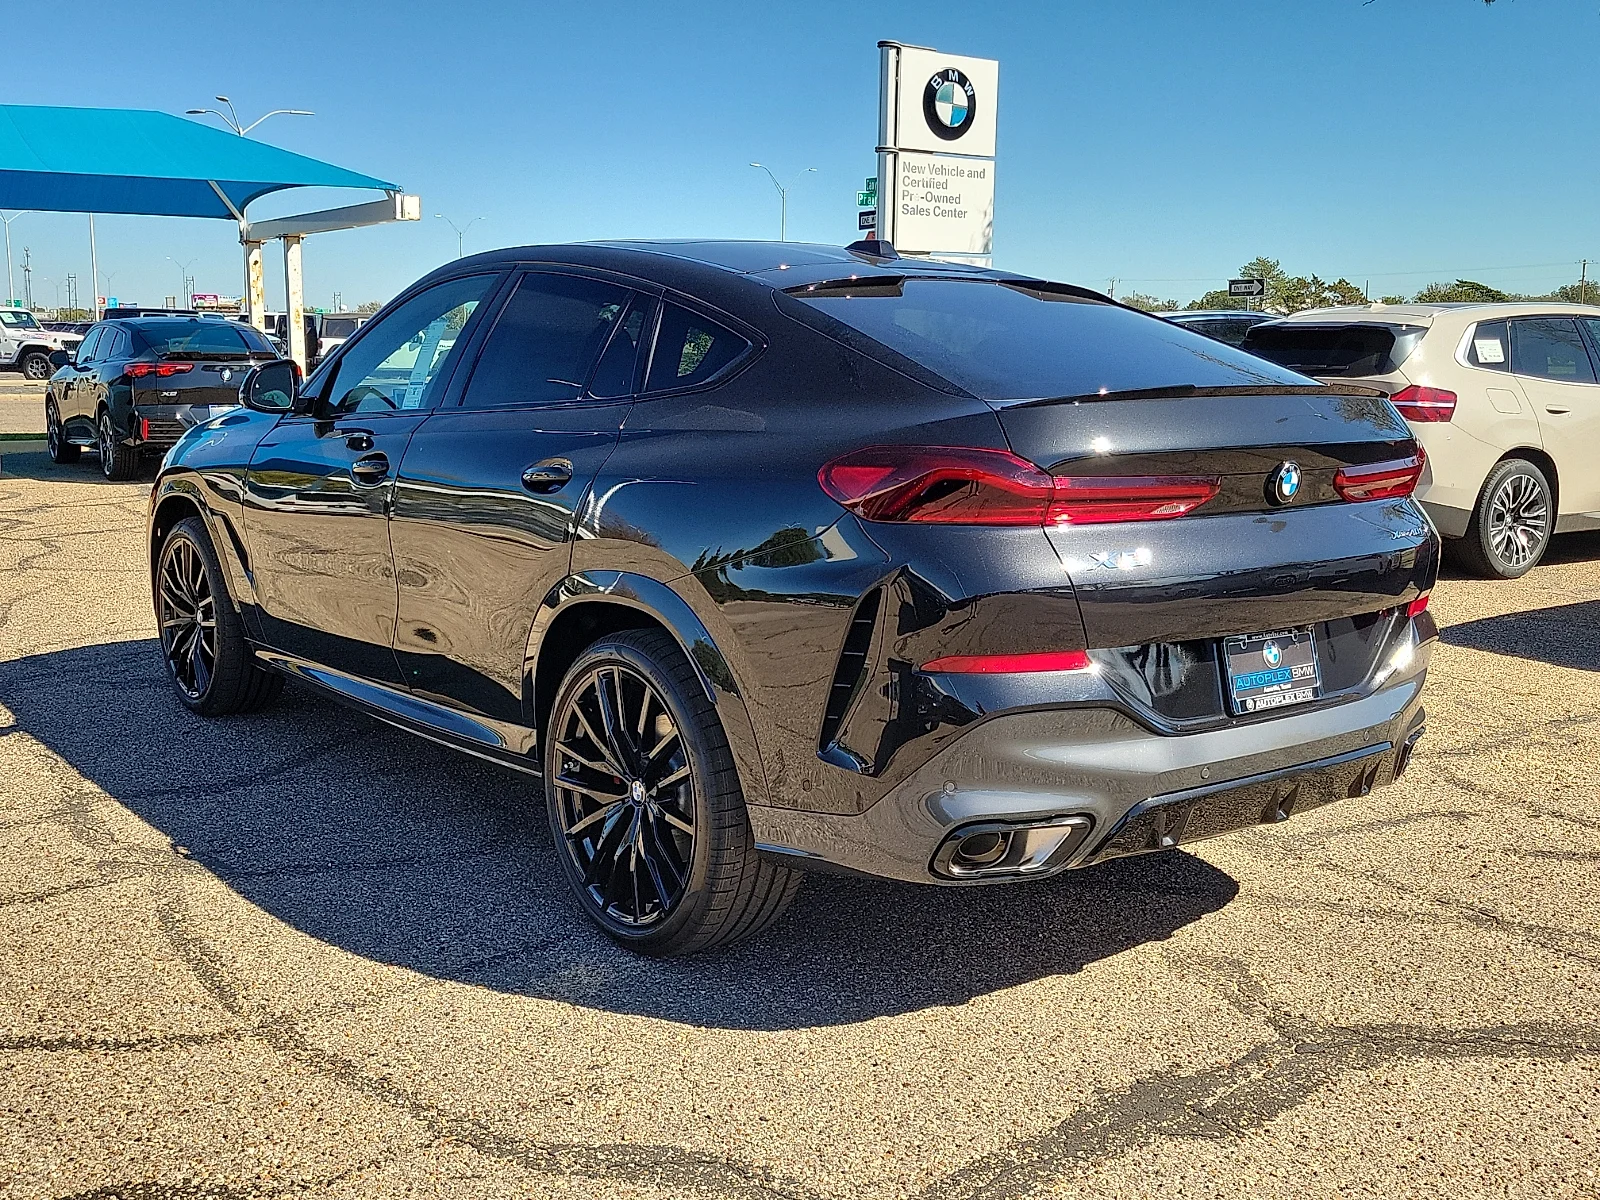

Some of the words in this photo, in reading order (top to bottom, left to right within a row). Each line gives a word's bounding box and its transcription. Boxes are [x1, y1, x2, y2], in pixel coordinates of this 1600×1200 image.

[930, 70, 974, 97] BMW
[902, 161, 926, 175] New
[928, 163, 965, 178] Vehicle
[967, 168, 986, 180] and
[902, 175, 948, 191] Certified
[902, 189, 961, 205] Pr-Owned
[901, 203, 931, 217] Sales
[933, 205, 968, 219] Center
[1236, 669, 1291, 688] AUTOPLEX
[1292, 666, 1313, 678] BMW
[1255, 694, 1296, 709] AUTOPLEX
[1296, 690, 1313, 703] BMW
